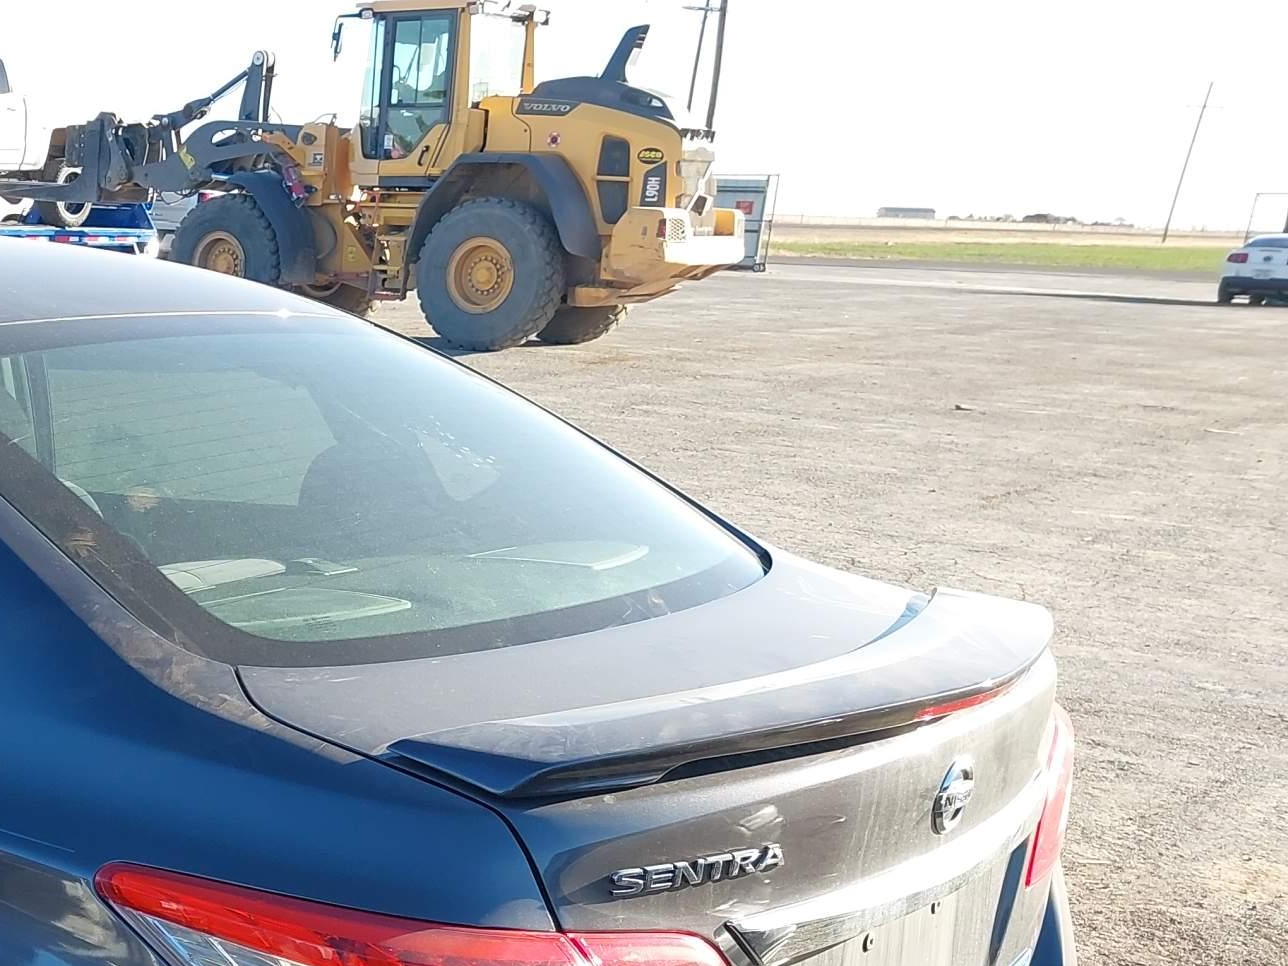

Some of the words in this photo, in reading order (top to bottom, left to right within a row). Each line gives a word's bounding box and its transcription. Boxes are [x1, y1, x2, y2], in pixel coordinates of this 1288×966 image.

[523, 102, 571, 113] VOLVO
[644, 176, 662, 202] L90H
[609, 842, 785, 898] SENTRA
